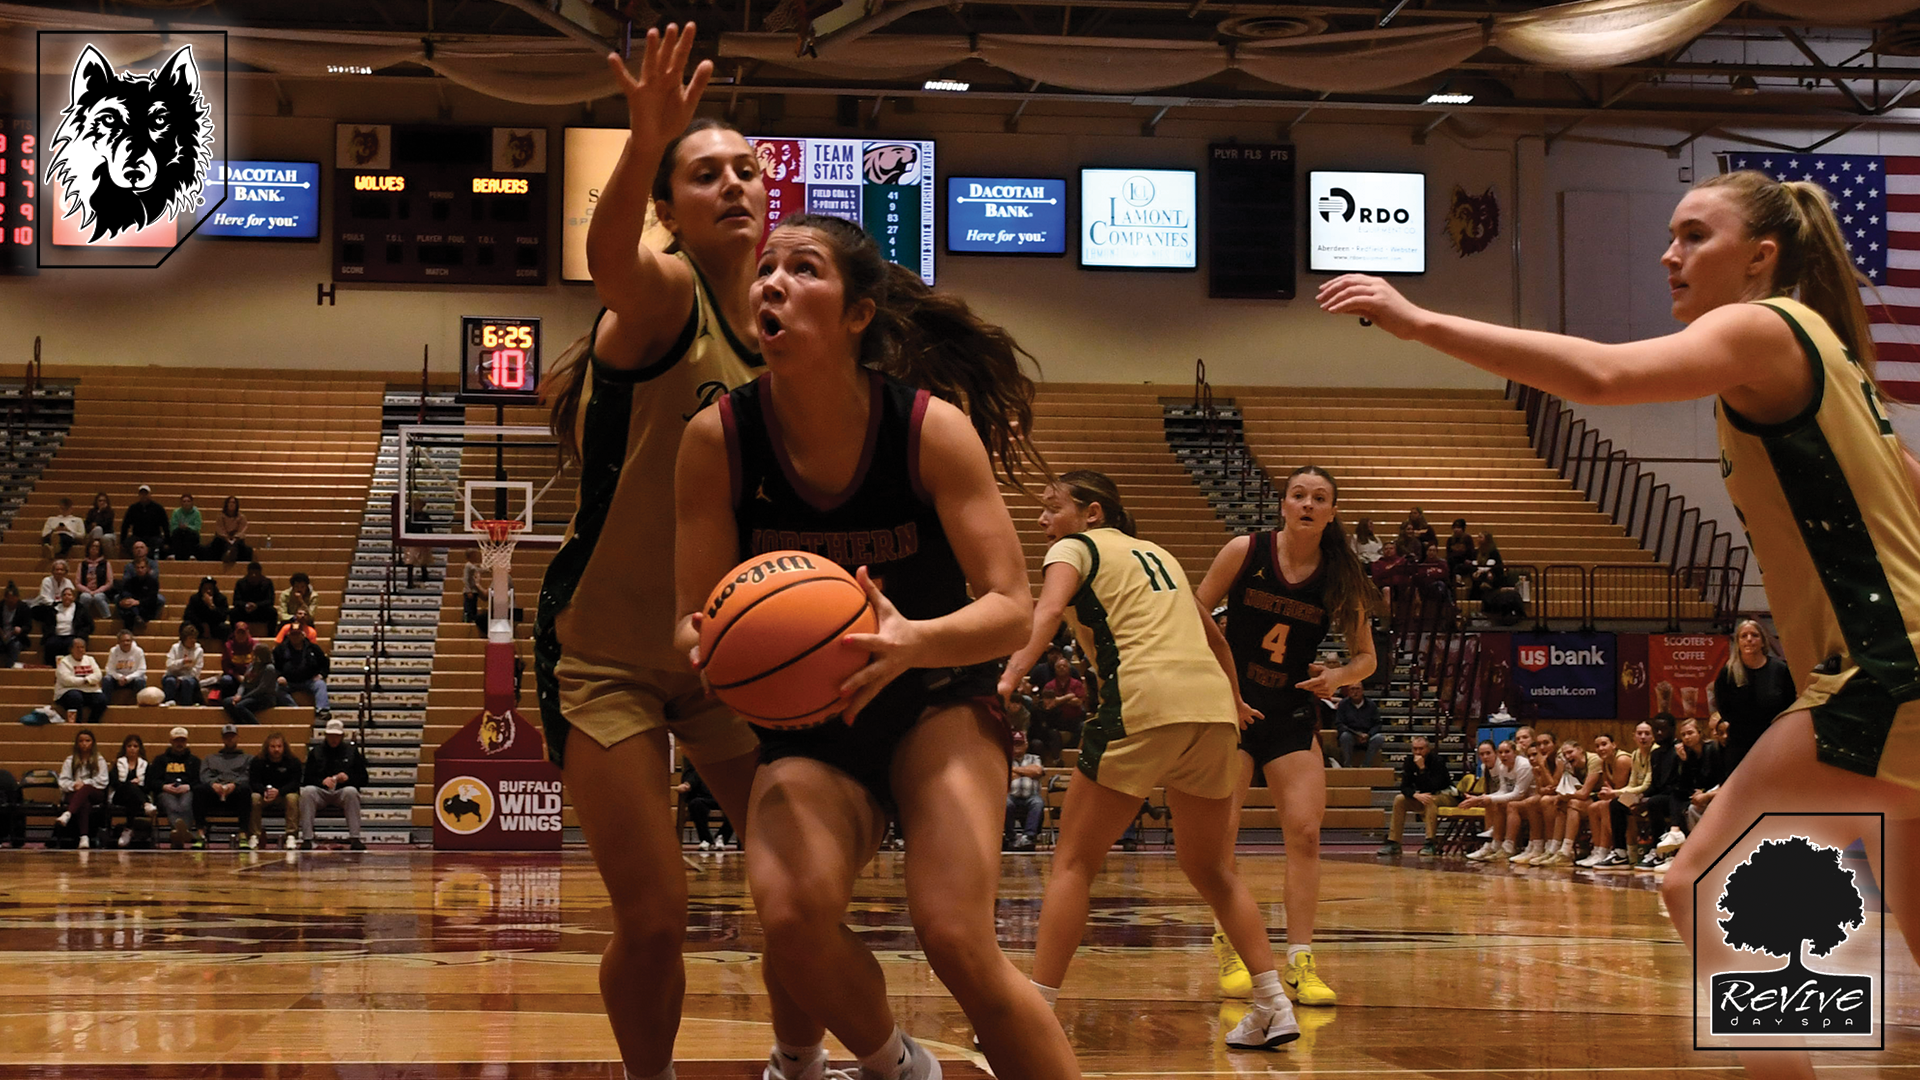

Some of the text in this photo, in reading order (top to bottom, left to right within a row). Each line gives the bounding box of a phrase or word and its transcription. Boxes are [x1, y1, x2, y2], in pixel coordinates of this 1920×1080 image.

[13, 119, 33, 130] PTS
[21, 134, 35, 154] 2
[814, 144, 854, 162] TEAM
[1214, 149, 1288, 160] PLYR FLS PTS
[20, 158, 35, 176] 4
[218, 165, 297, 182] DACOTAH
[814, 163, 854, 180] STATS
[22, 180, 34, 198] 7
[355, 175, 405, 191] WOLVES
[472, 178, 528, 193] BEAVERS
[969, 183, 1045, 199] DACOTAH
[769, 189, 781, 198] 40
[812, 189, 831, 198] FIELD
[832, 189, 849, 198] GOAL
[887, 192, 899, 200] 41
[769, 200, 781, 209] 21
[812, 200, 839, 209] 3-POINT
[840, 201, 850, 209] FG
[889, 203, 896, 211] 9
[922, 179, 933, 225] UNIVERSITY
[20, 203, 33, 221] 9
[768, 211, 781, 220] 67
[887, 214, 899, 222] 83
[1109, 196, 1189, 229] LAMONT
[1360, 208, 1410, 224] RDO
[214, 213, 245, 225] Here
[243, 213, 266, 229] for
[13, 226, 33, 245] 10
[887, 225, 899, 234] 27
[966, 229, 996, 241] Here
[995, 229, 1016, 245] for
[1089, 220, 1189, 247] COMPANIES
[416, 235, 443, 243] PLAYER
[889, 237, 896, 245] 4
[890, 249, 896, 257] 1
[425, 268, 449, 276] MATCH
[318, 283, 336, 305] H
[483, 325, 533, 348] 6:25
[491, 349, 525, 389] 10
[1131, 549, 1178, 592] 11
[707, 555, 817, 620] Wilson
[1243, 587, 1326, 626] NORTHERN
[1261, 622, 1292, 664] 4
[1664, 637, 1714, 647] SCOOTER'S
[1520, 645, 1606, 666] us bank
[1672, 651, 1706, 660] COFFEE
[1530, 686, 1597, 696] usbank.com
[499, 780, 562, 793] BUFFALO
[499, 794, 562, 815] WILD
[499, 815, 562, 832] WINGS
